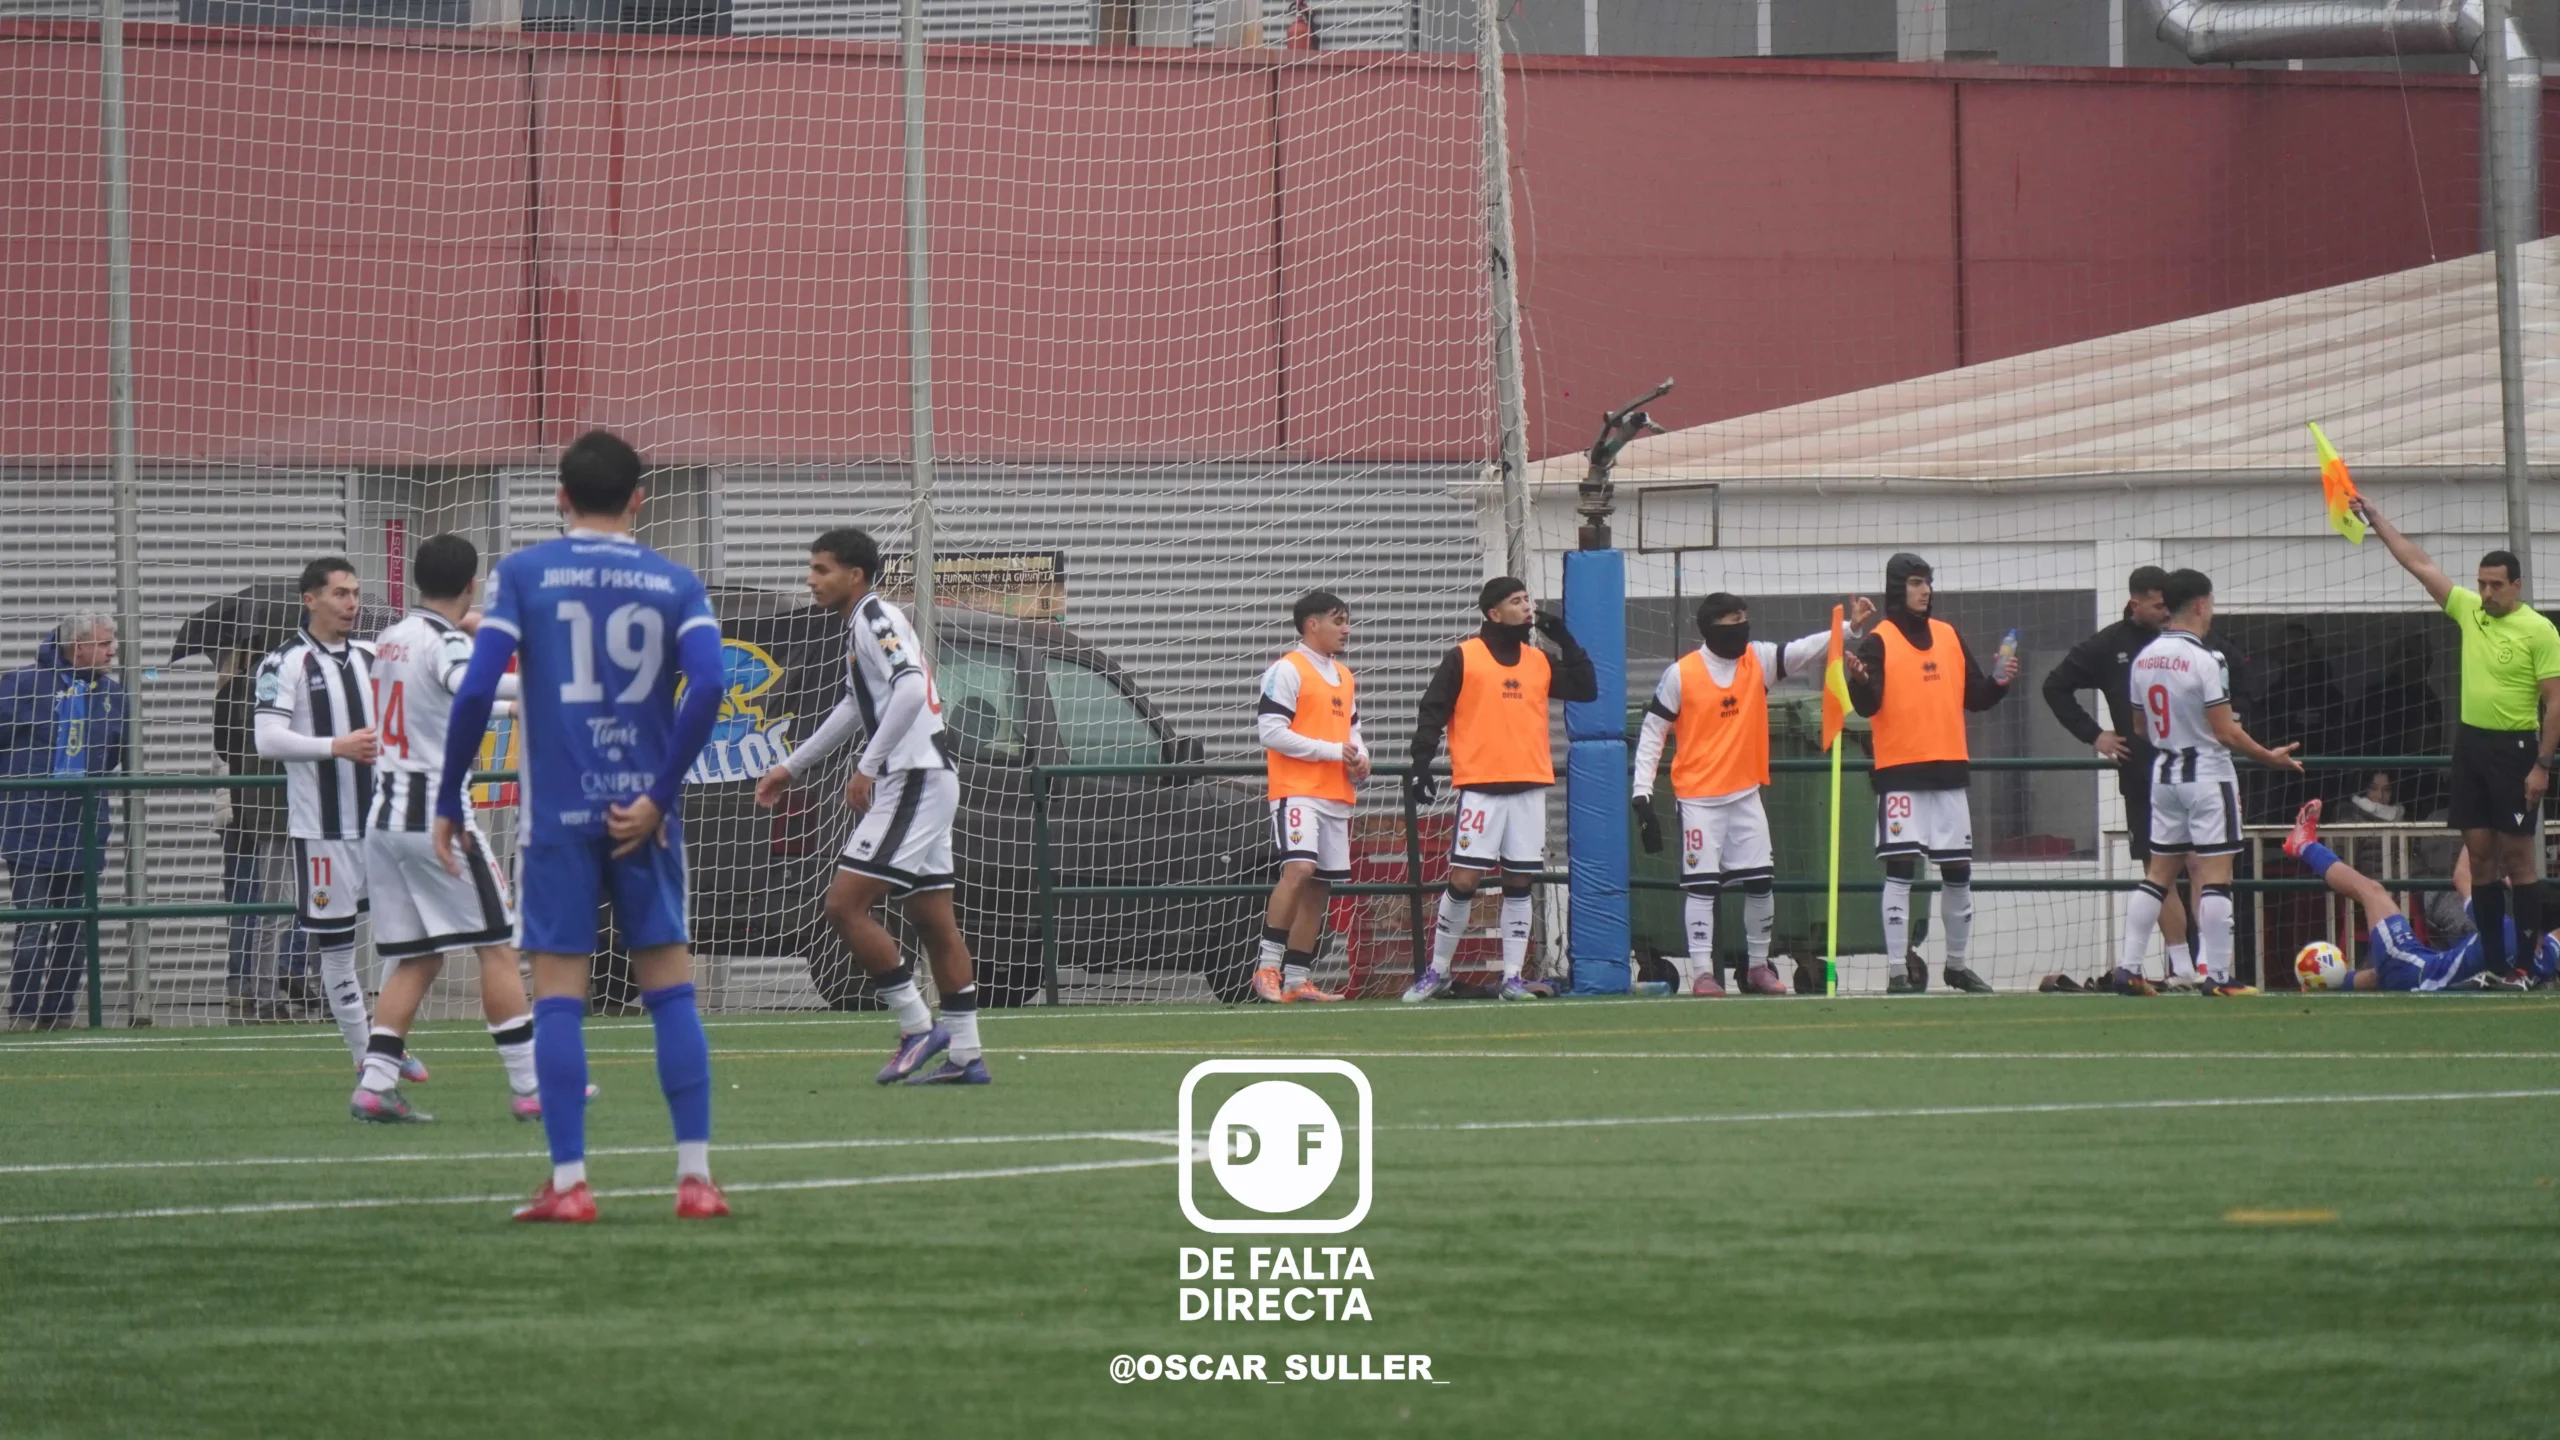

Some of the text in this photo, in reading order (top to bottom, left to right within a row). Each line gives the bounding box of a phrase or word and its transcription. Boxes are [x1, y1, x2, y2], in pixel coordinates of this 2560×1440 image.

[540, 568, 677, 594] JAUME PASCUAL
[556, 600, 664, 704] 19
[2136, 656, 2191, 672] MIGUELÓN
[2147, 684, 2170, 739] 9
[1289, 807, 1302, 828] 8
[1887, 795, 1911, 819] 29
[1458, 808, 1486, 834] 24
[1685, 829, 1703, 851] 19
[310, 857, 331, 886] 11
